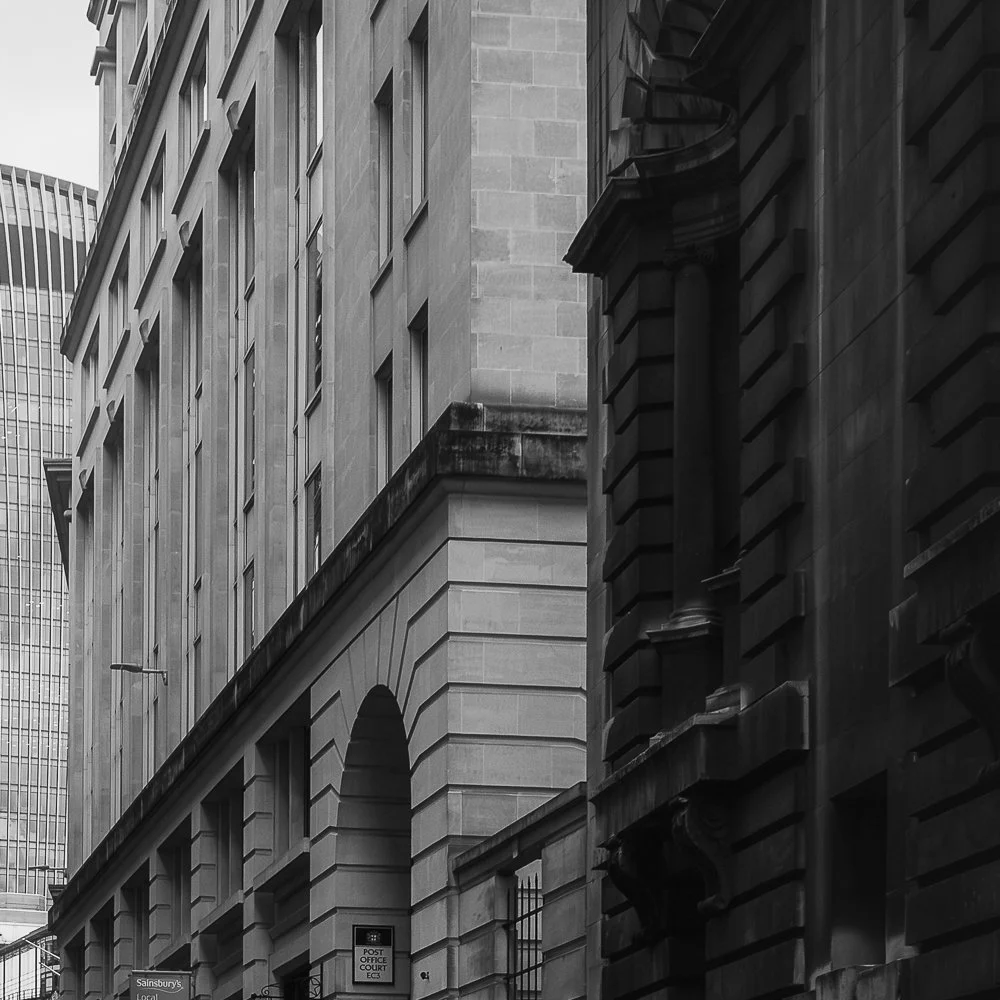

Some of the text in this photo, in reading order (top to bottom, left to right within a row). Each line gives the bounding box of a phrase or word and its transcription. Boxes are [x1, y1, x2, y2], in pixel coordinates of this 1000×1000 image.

[363, 948, 384, 956] POST
[360, 956, 388, 964] OFFICE
[136, 978, 182, 989] Sainsbury's
